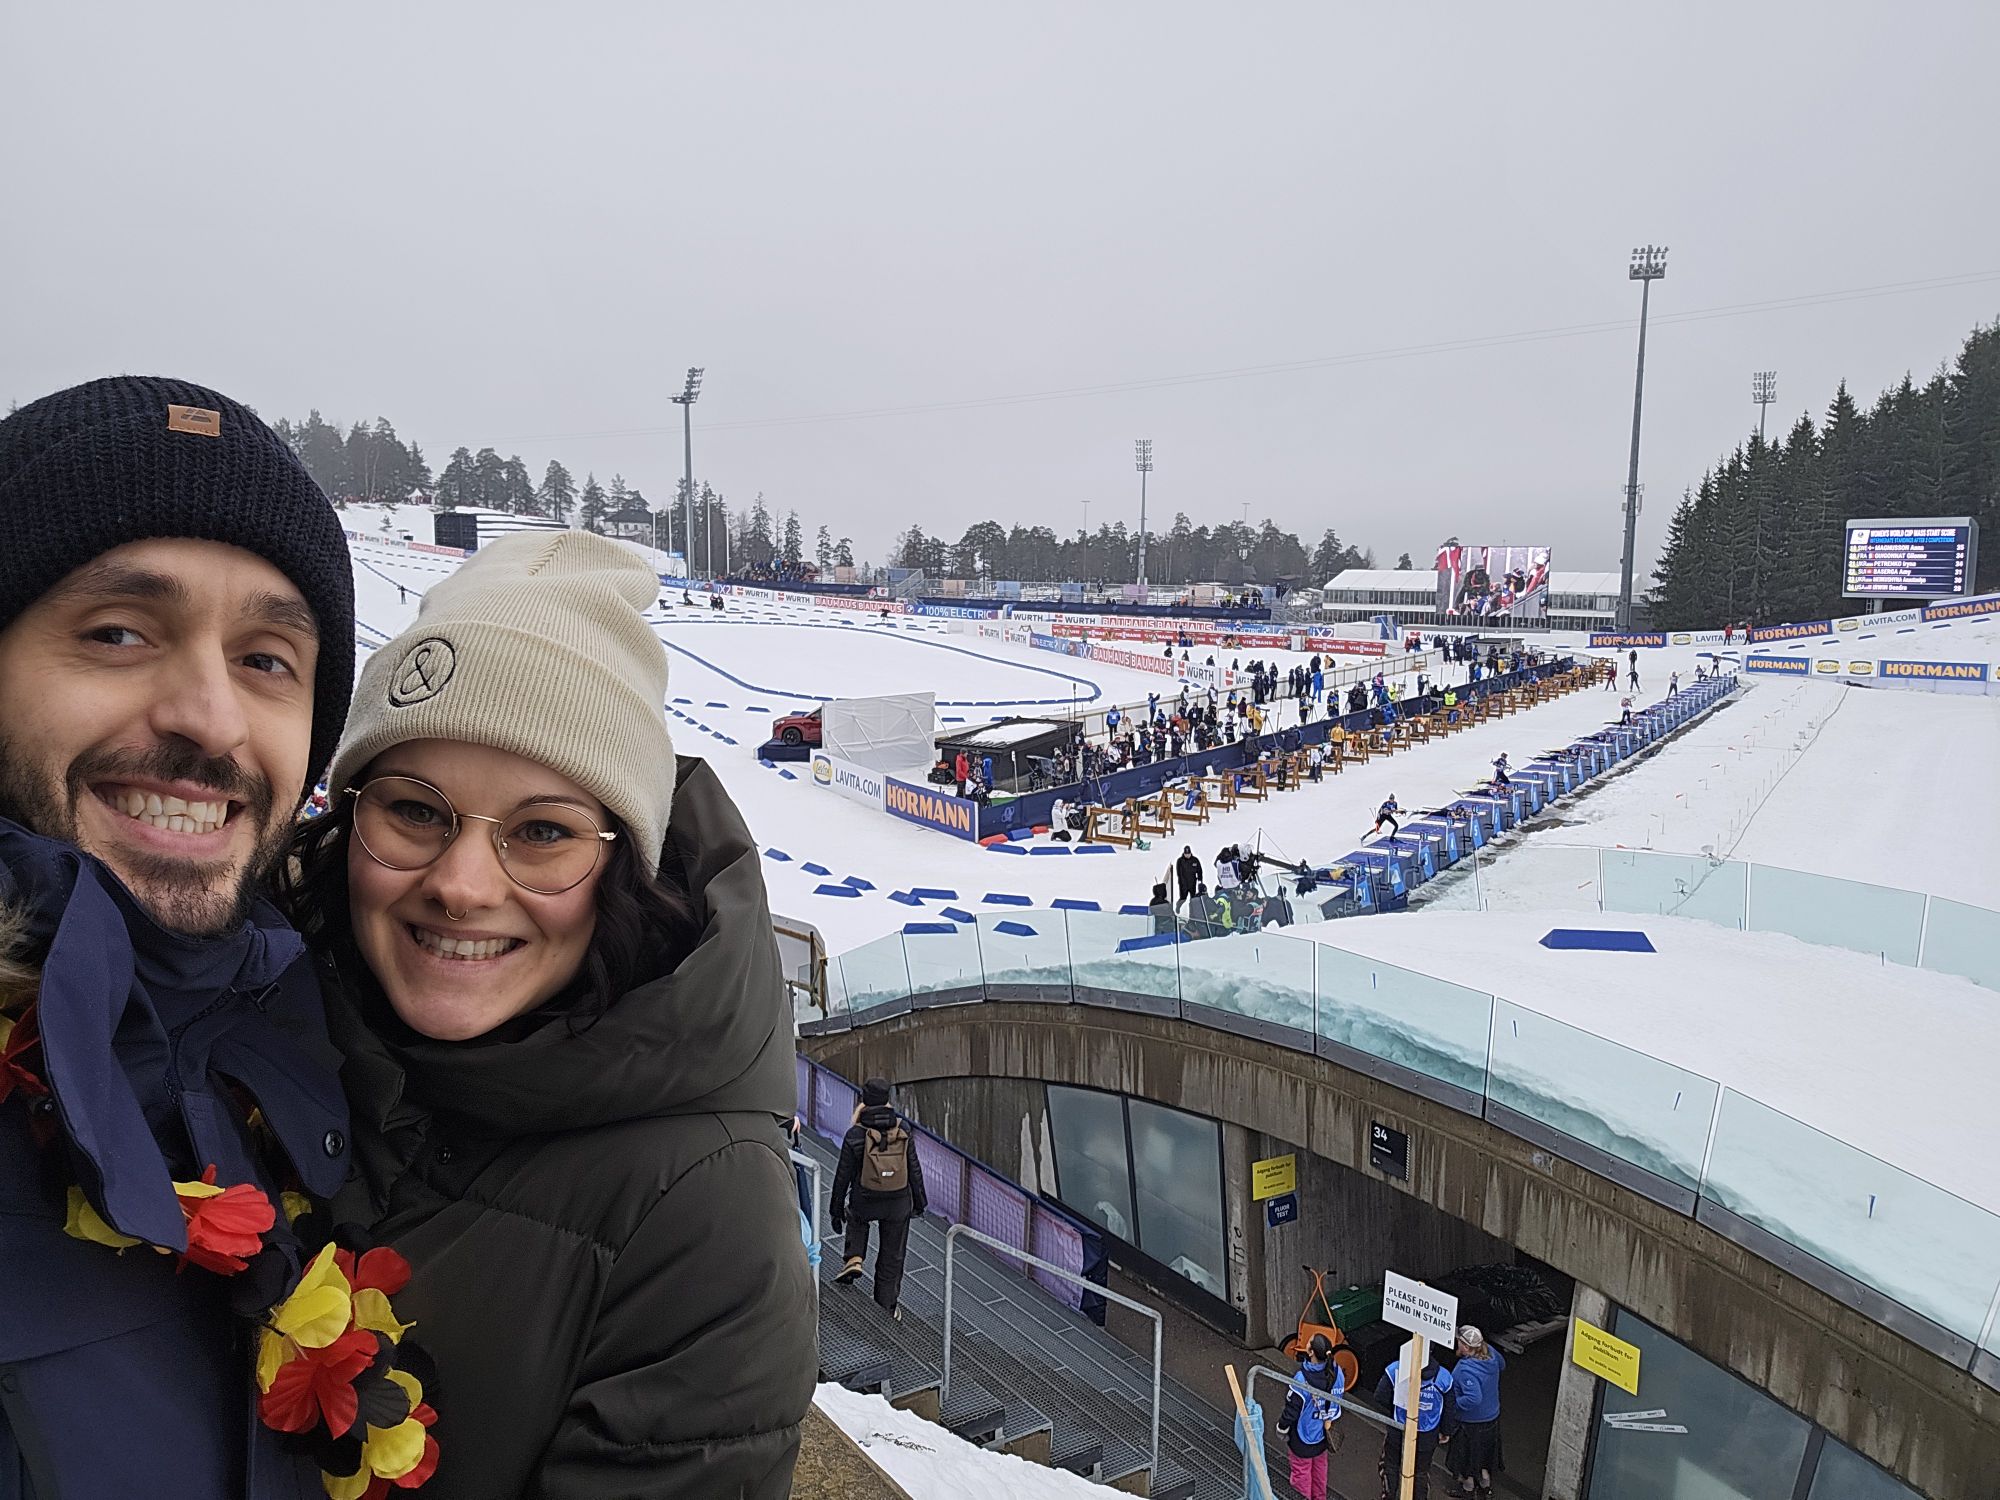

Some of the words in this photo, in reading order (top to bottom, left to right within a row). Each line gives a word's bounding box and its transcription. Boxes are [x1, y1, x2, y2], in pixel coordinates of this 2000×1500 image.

[815, 597, 858, 609] BAUHAUS
[858, 600, 903, 613] BAUHAUS
[925, 606, 949, 617] 100%
[950, 608, 992, 619] ELECTRIC
[1102, 616, 1156, 628] BAUHAUS
[1863, 613, 1917, 627] LAVITA.COM
[1312, 627, 1334, 638] iX2
[1695, 634, 1745, 642] LAVITAOM
[1753, 623, 1828, 642] HÖRMANN
[1093, 646, 1130, 667] BAUHAUS
[1131, 654, 1173, 675] BAUHAUS
[1748, 660, 1806, 671] HÖRMANN
[1886, 663, 1981, 678] HÖRMANN
[835, 767, 881, 799] LAVITA.COM
[887, 783, 970, 832] HÖRMANN
[1373, 1126, 1388, 1141] 34
[1271, 1163, 1285, 1171] forbudt
[1274, 1203, 1290, 1213] FLUOR
[1276, 1210, 1289, 1219] TEST
[1388, 1286, 1417, 1305] PLEASE
[1418, 1298, 1430, 1310] DO
[1431, 1304, 1449, 1317] NOT
[1385, 1297, 1411, 1315] STAND
[1412, 1308, 1422, 1319] IN
[1422, 1312, 1452, 1332] STAIRS
[1580, 1330, 1601, 1346] Adgang
[1601, 1340, 1624, 1357] forbudt
[1624, 1352, 1634, 1361] for
[1593, 1345, 1619, 1362] publikum
